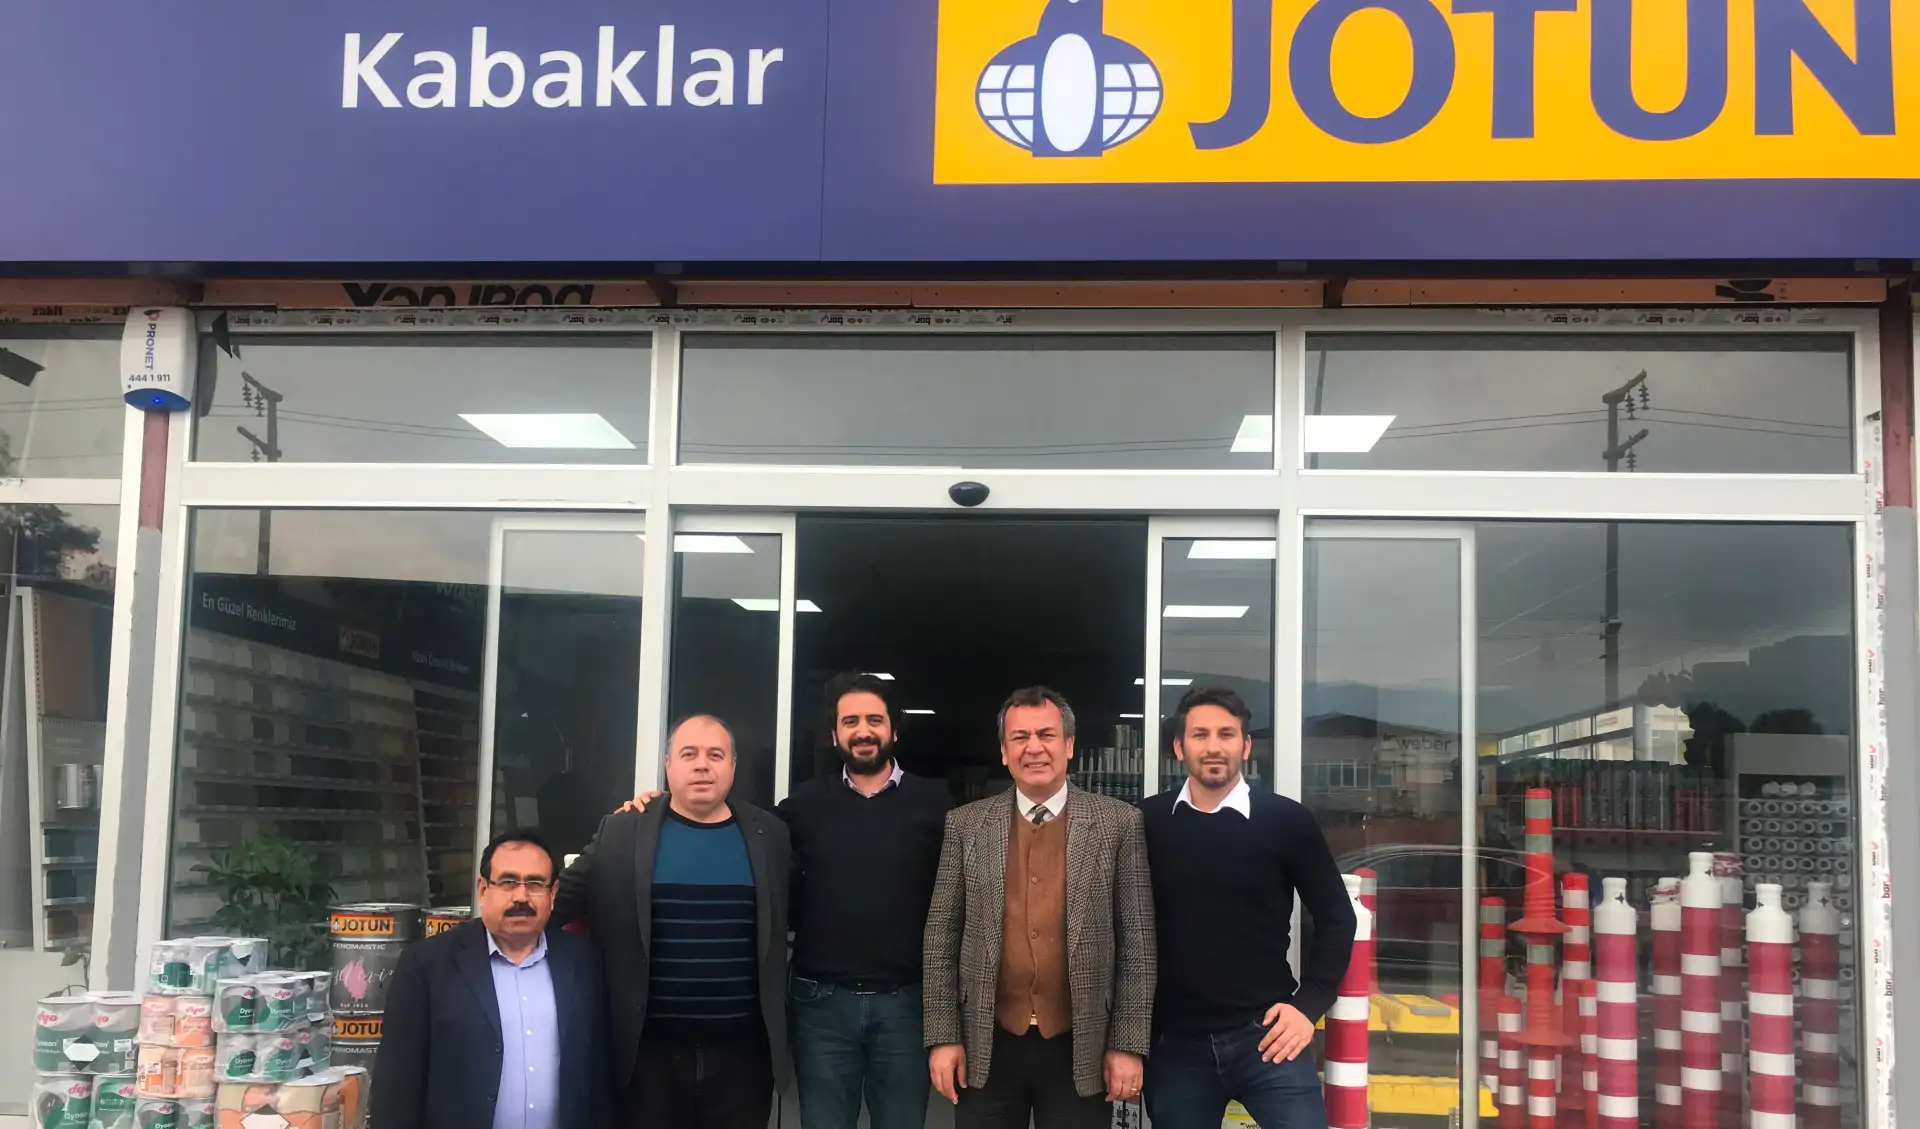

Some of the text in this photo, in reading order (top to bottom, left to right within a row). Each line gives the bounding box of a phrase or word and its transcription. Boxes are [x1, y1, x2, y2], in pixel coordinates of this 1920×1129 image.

[342, 25, 784, 108] Kabaklar
[1188, 0, 1896, 149] JOTUN
[145, 323, 156, 370] PRONET
[129, 374, 147, 382] 444
[157, 374, 171, 382] 911
[202, 593, 297, 632] En Güzel Renklerimiz
[1397, 735, 1452, 751] weber
[341, 919, 391, 932] JOTUN
[333, 942, 386, 950] FENOMASTIC
